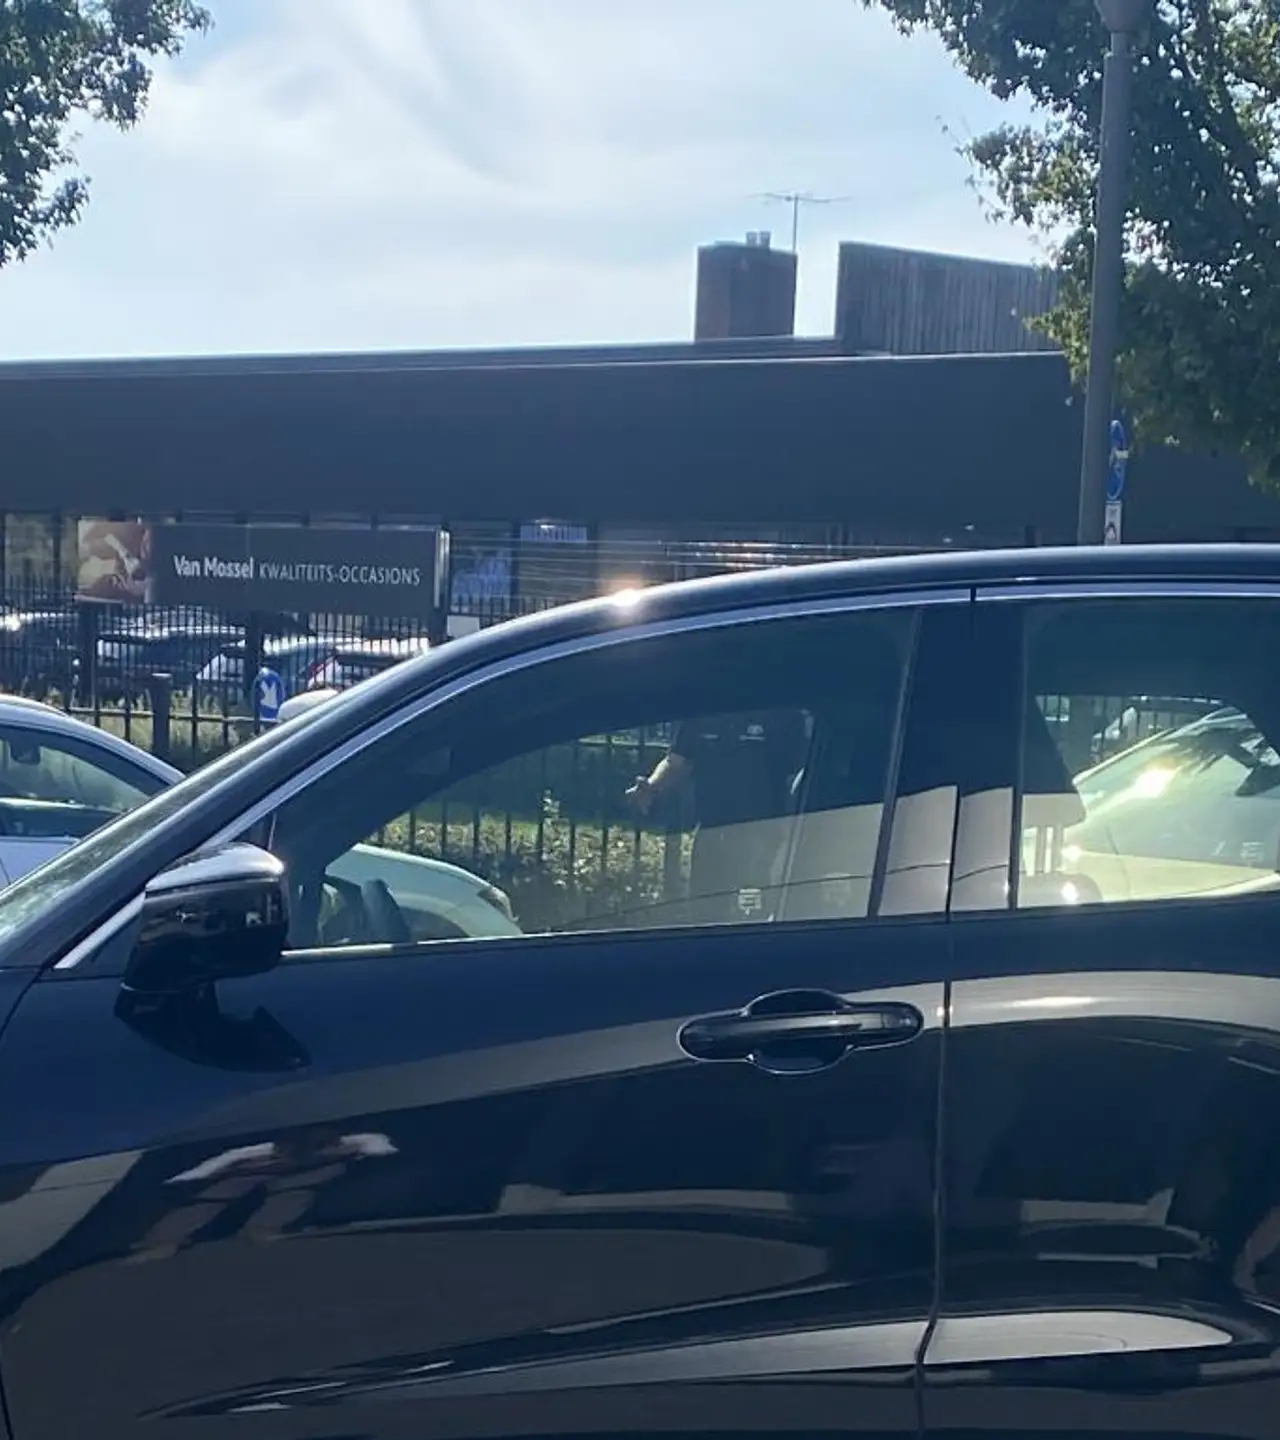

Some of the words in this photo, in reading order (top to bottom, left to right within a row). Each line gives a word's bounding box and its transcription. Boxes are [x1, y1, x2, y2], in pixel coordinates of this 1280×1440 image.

[173, 556, 201, 577] Van
[204, 557, 254, 579] Mossel
[259, 564, 421, 586] KWALITEITS-OCCASIONS
